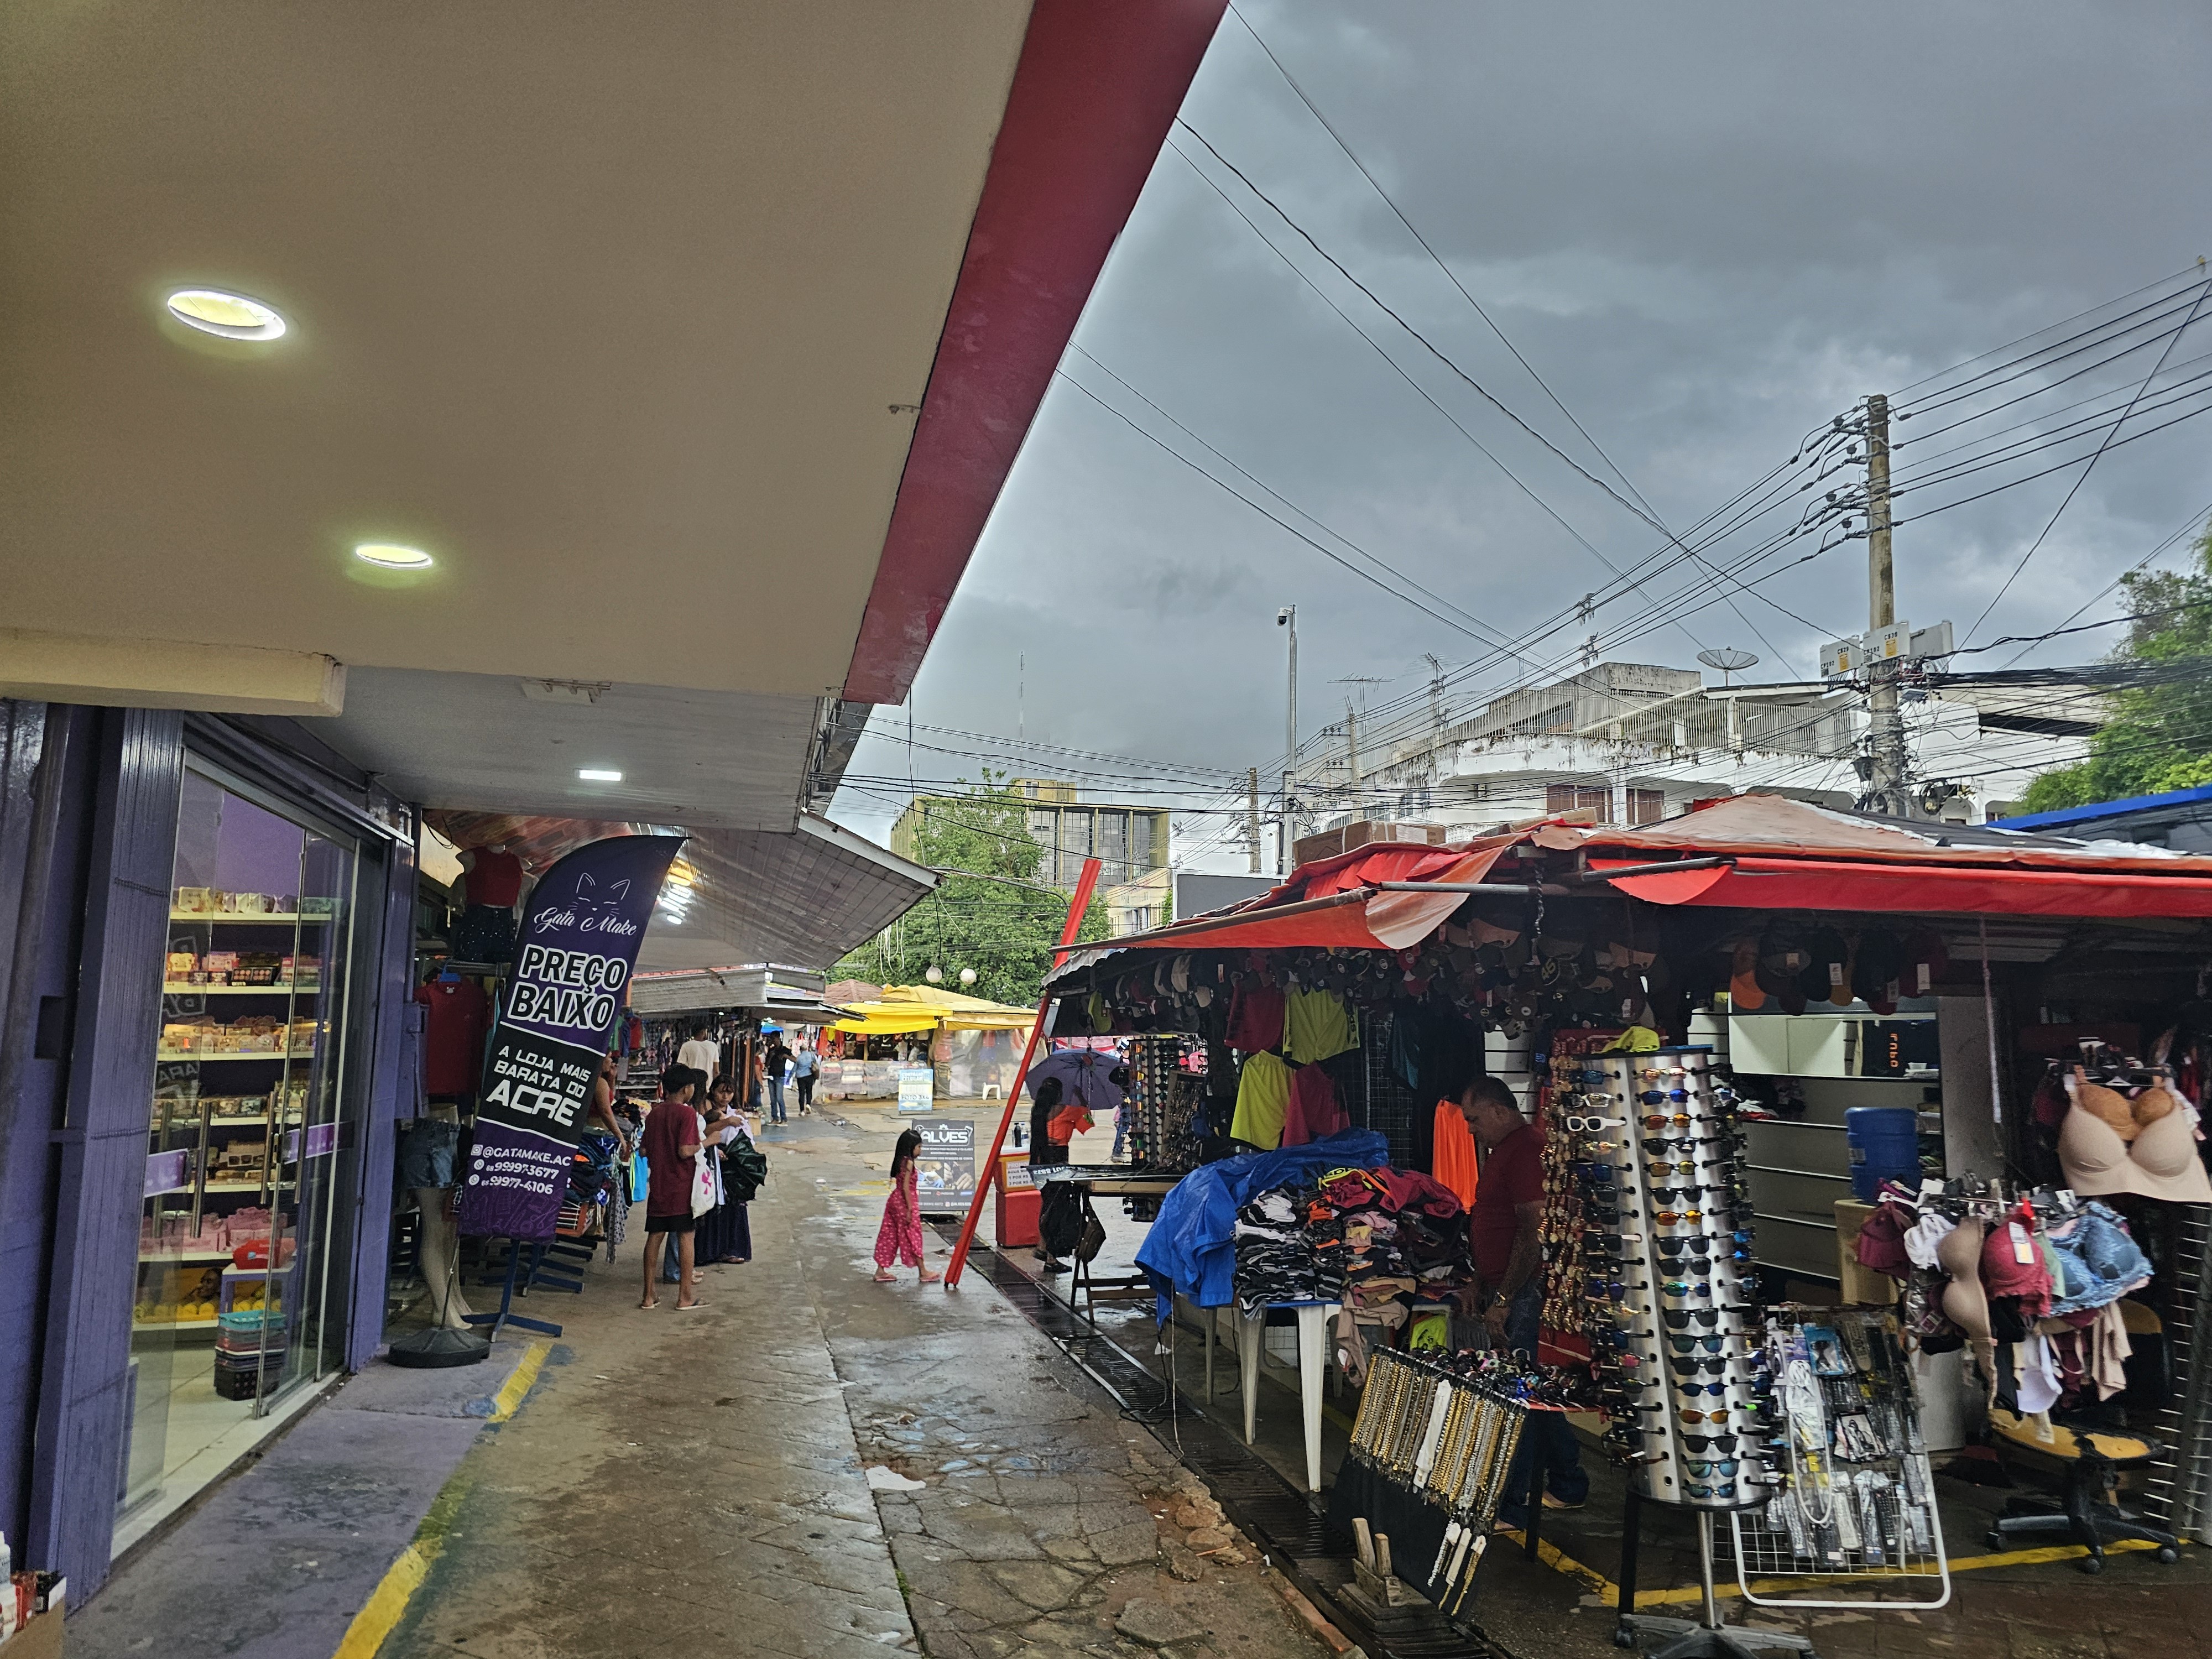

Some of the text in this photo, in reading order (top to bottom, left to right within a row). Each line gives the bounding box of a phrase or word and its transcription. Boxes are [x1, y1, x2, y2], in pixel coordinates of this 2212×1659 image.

[534, 907, 637, 935] Gata Make
[518, 943, 628, 994] PREÇO
[507, 982, 615, 1031] BAIXO
[494, 1060, 586, 1098] BARATA DO
[498, 1045, 591, 1082] A LOJA MAIS
[486, 1079, 582, 1126] ACRE
[921, 1131, 968, 1143] ALVES
[483, 1146, 572, 1166] @GATAMAKE.AC
